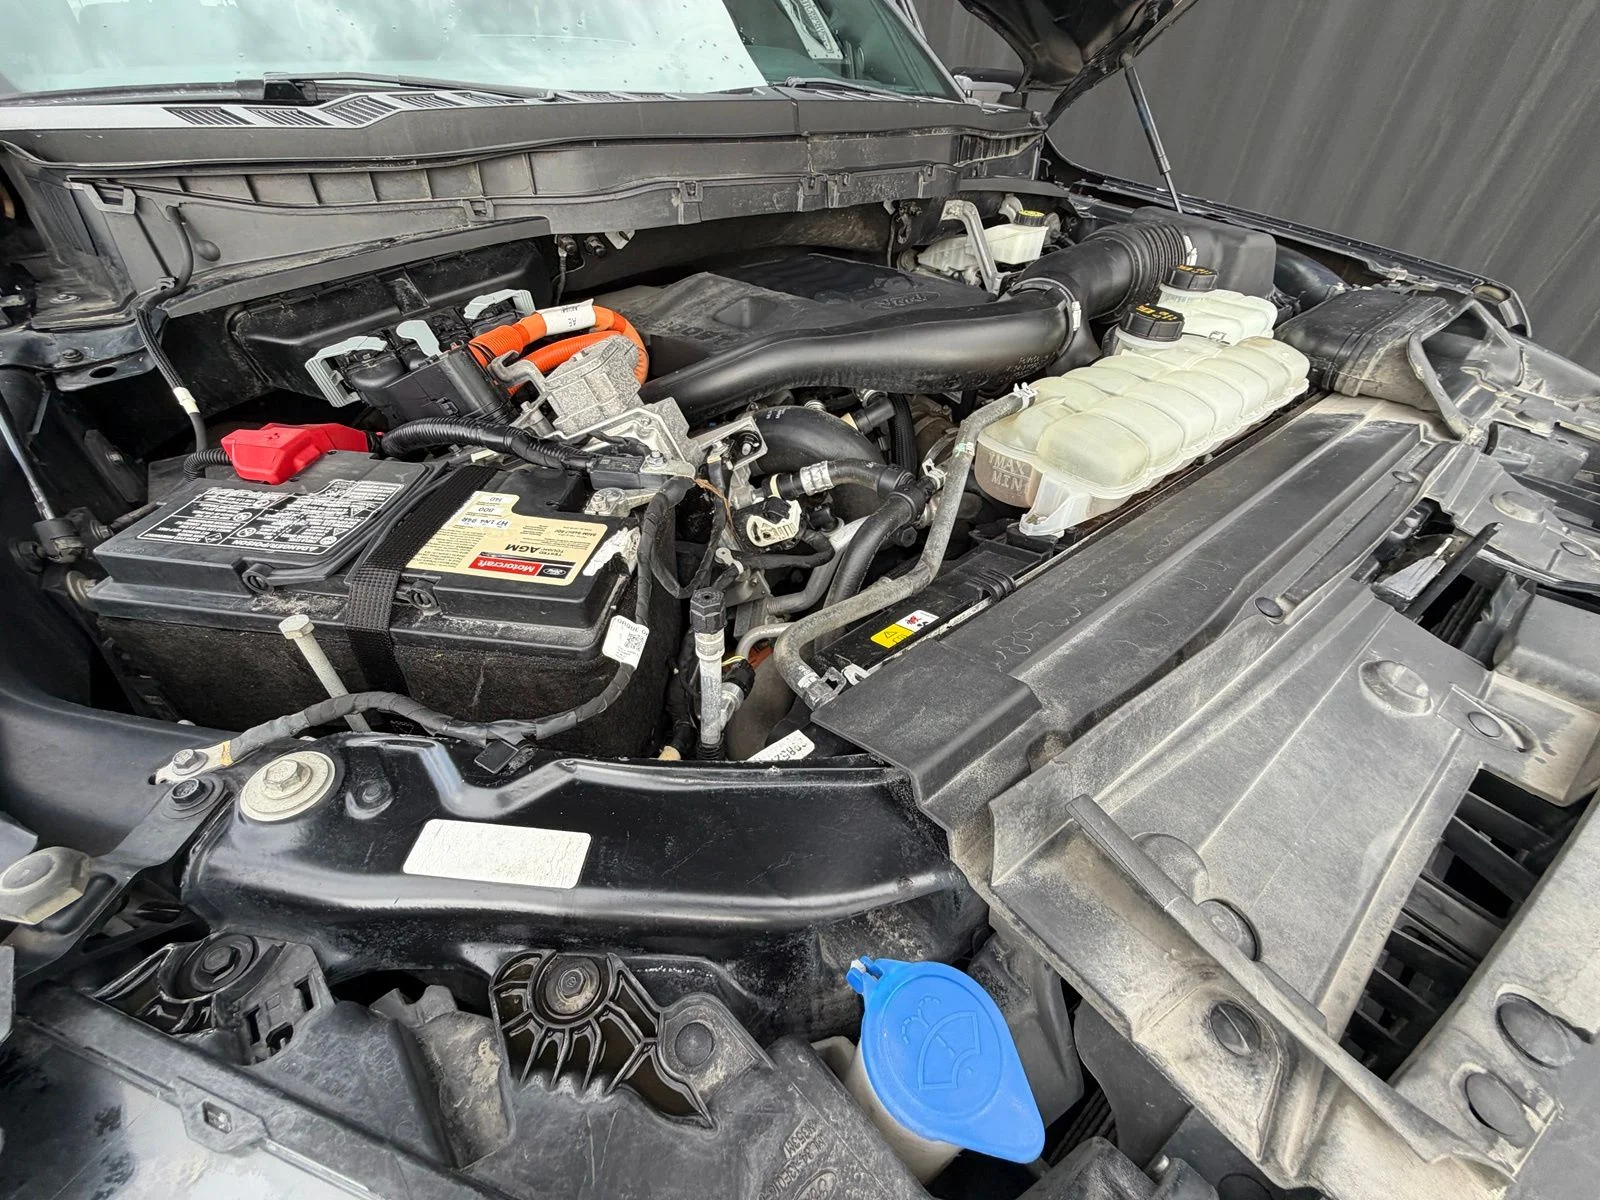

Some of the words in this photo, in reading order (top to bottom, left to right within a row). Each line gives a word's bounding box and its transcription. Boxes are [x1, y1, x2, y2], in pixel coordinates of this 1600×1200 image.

[993, 454, 1028, 476] MAX
[991, 470, 1024, 491] MIN
[231, 539, 311, 551] DANGER/POISON
[504, 543, 540, 554] AGM
[477, 560, 536, 573] Motorcraft
